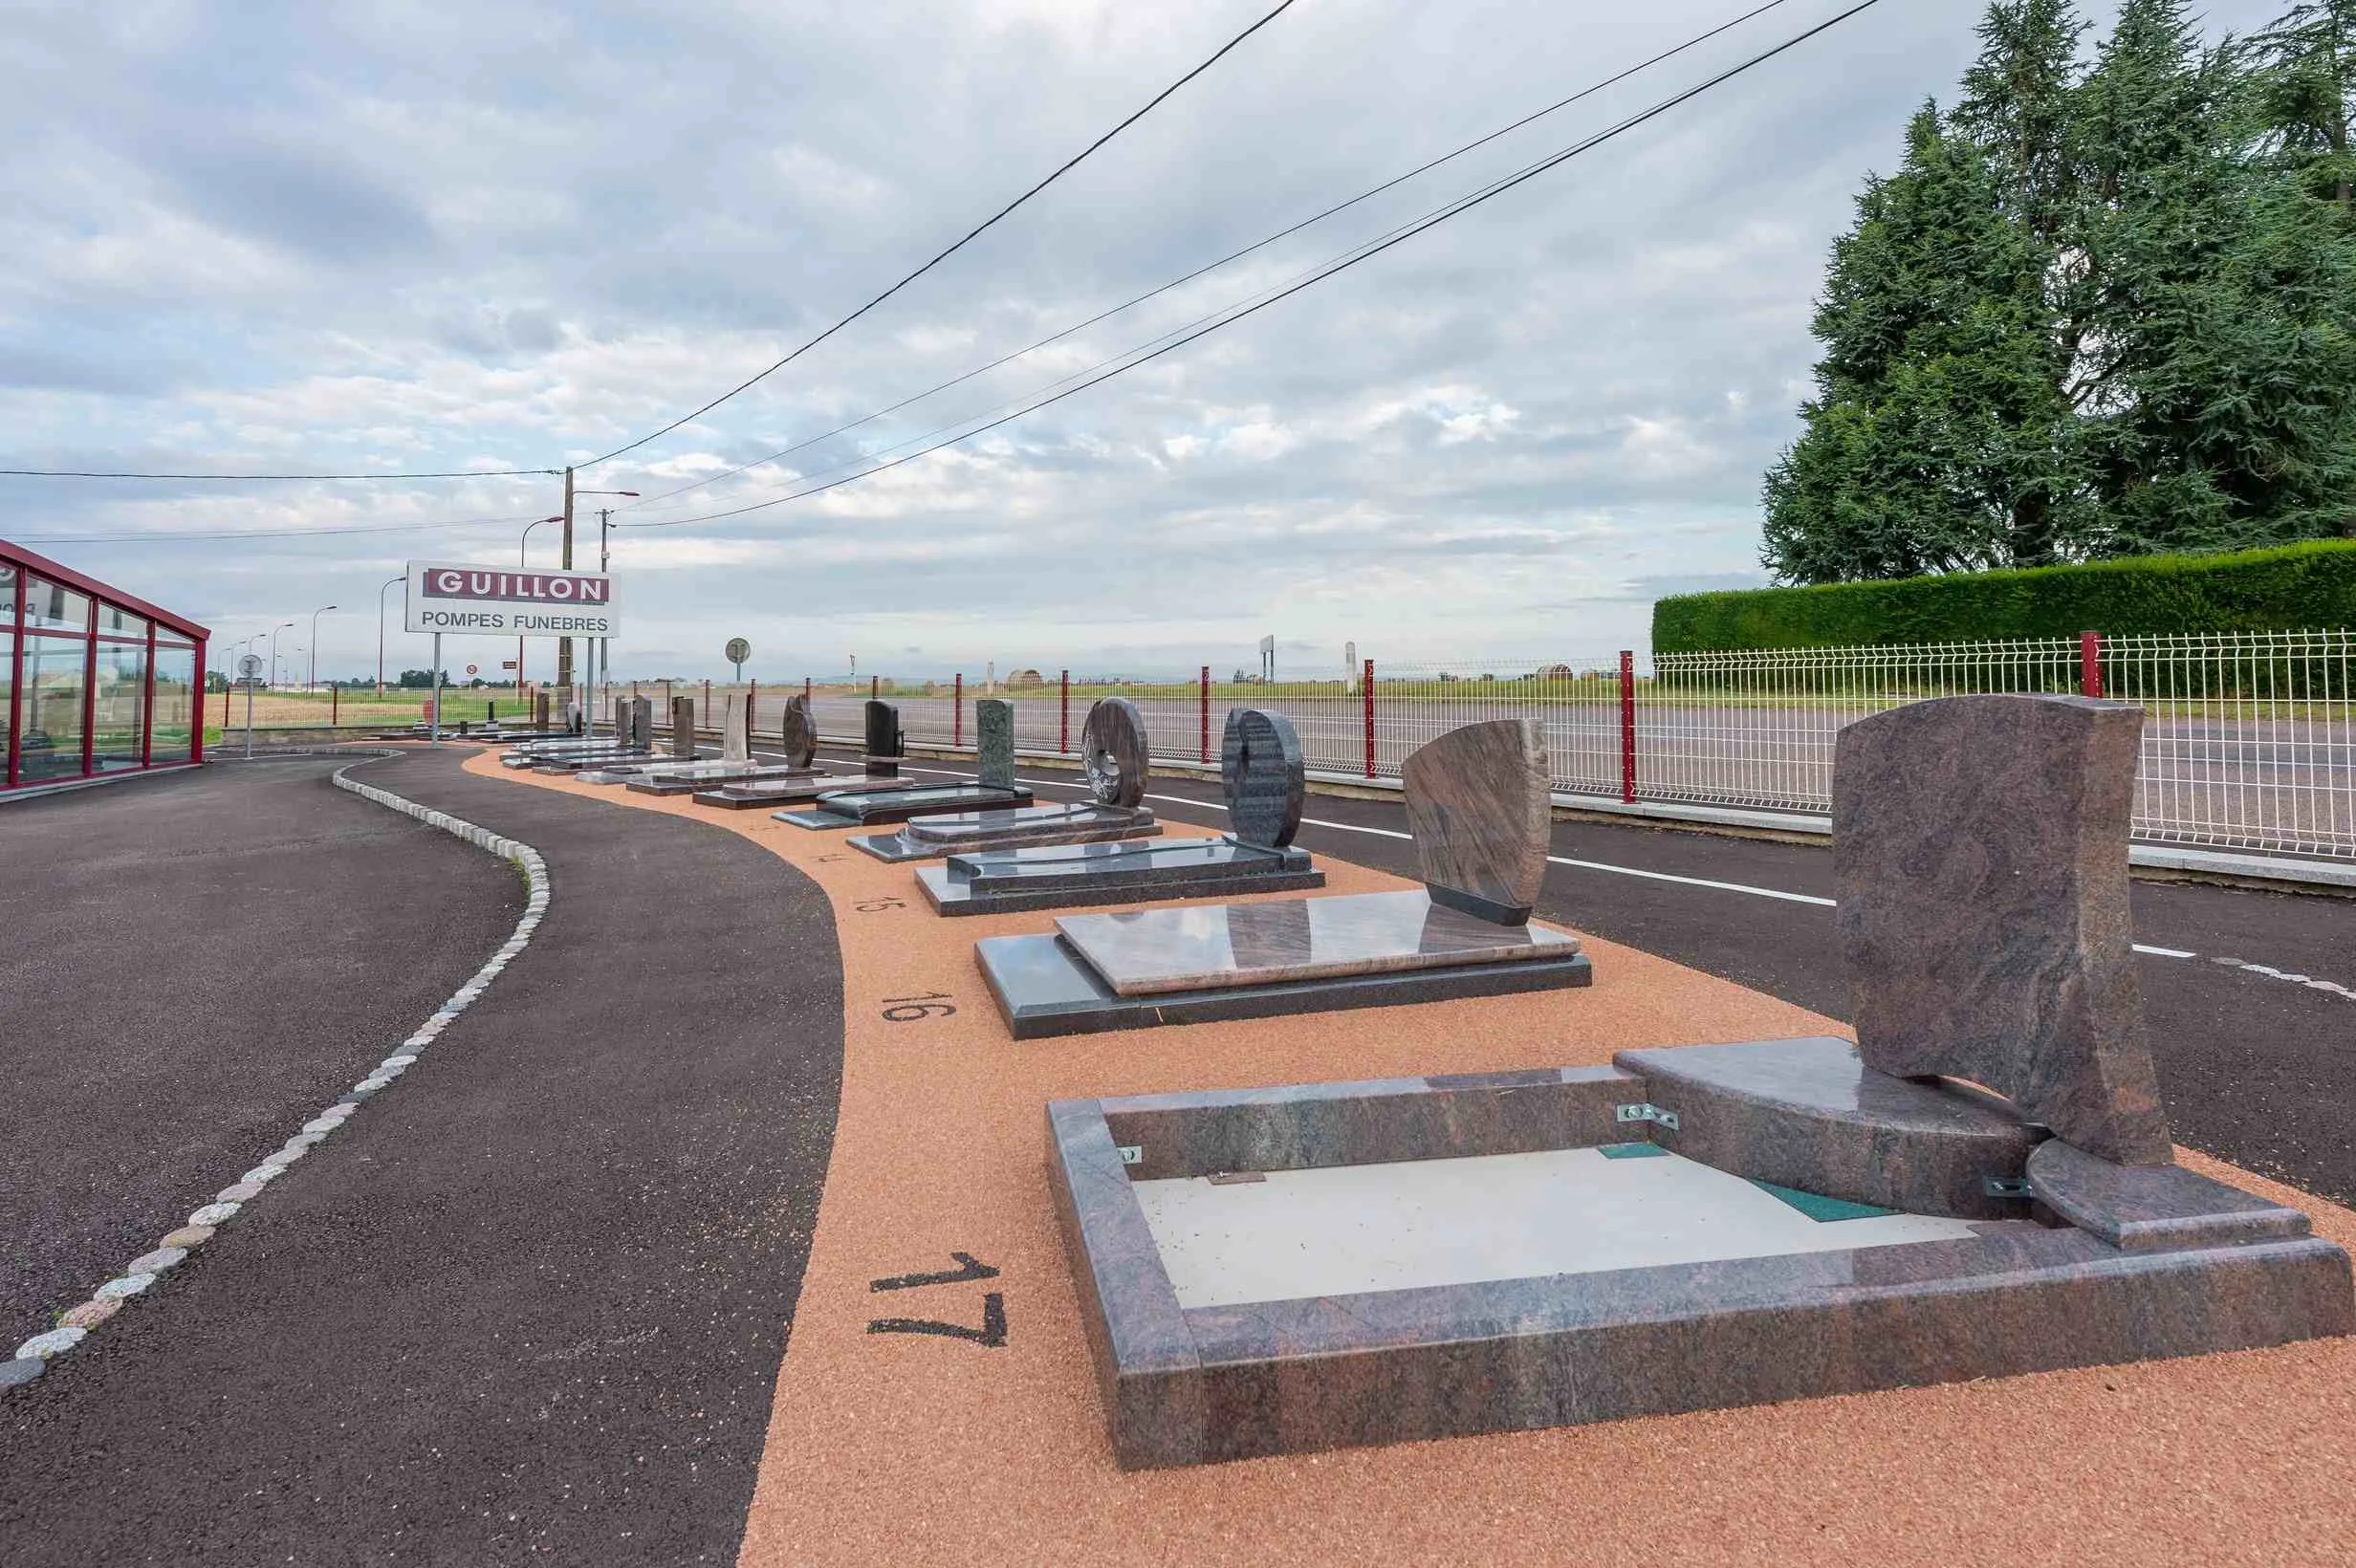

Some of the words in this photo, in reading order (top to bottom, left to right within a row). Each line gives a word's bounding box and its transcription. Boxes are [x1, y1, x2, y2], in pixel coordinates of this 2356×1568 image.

[438, 571, 601, 600] GUILLON
[422, 611, 505, 628] POMPES
[513, 615, 608, 631] FUNEBRES
[854, 896, 906, 912] 15
[881, 991, 957, 1022] 16
[865, 1251, 1009, 1348] 17
